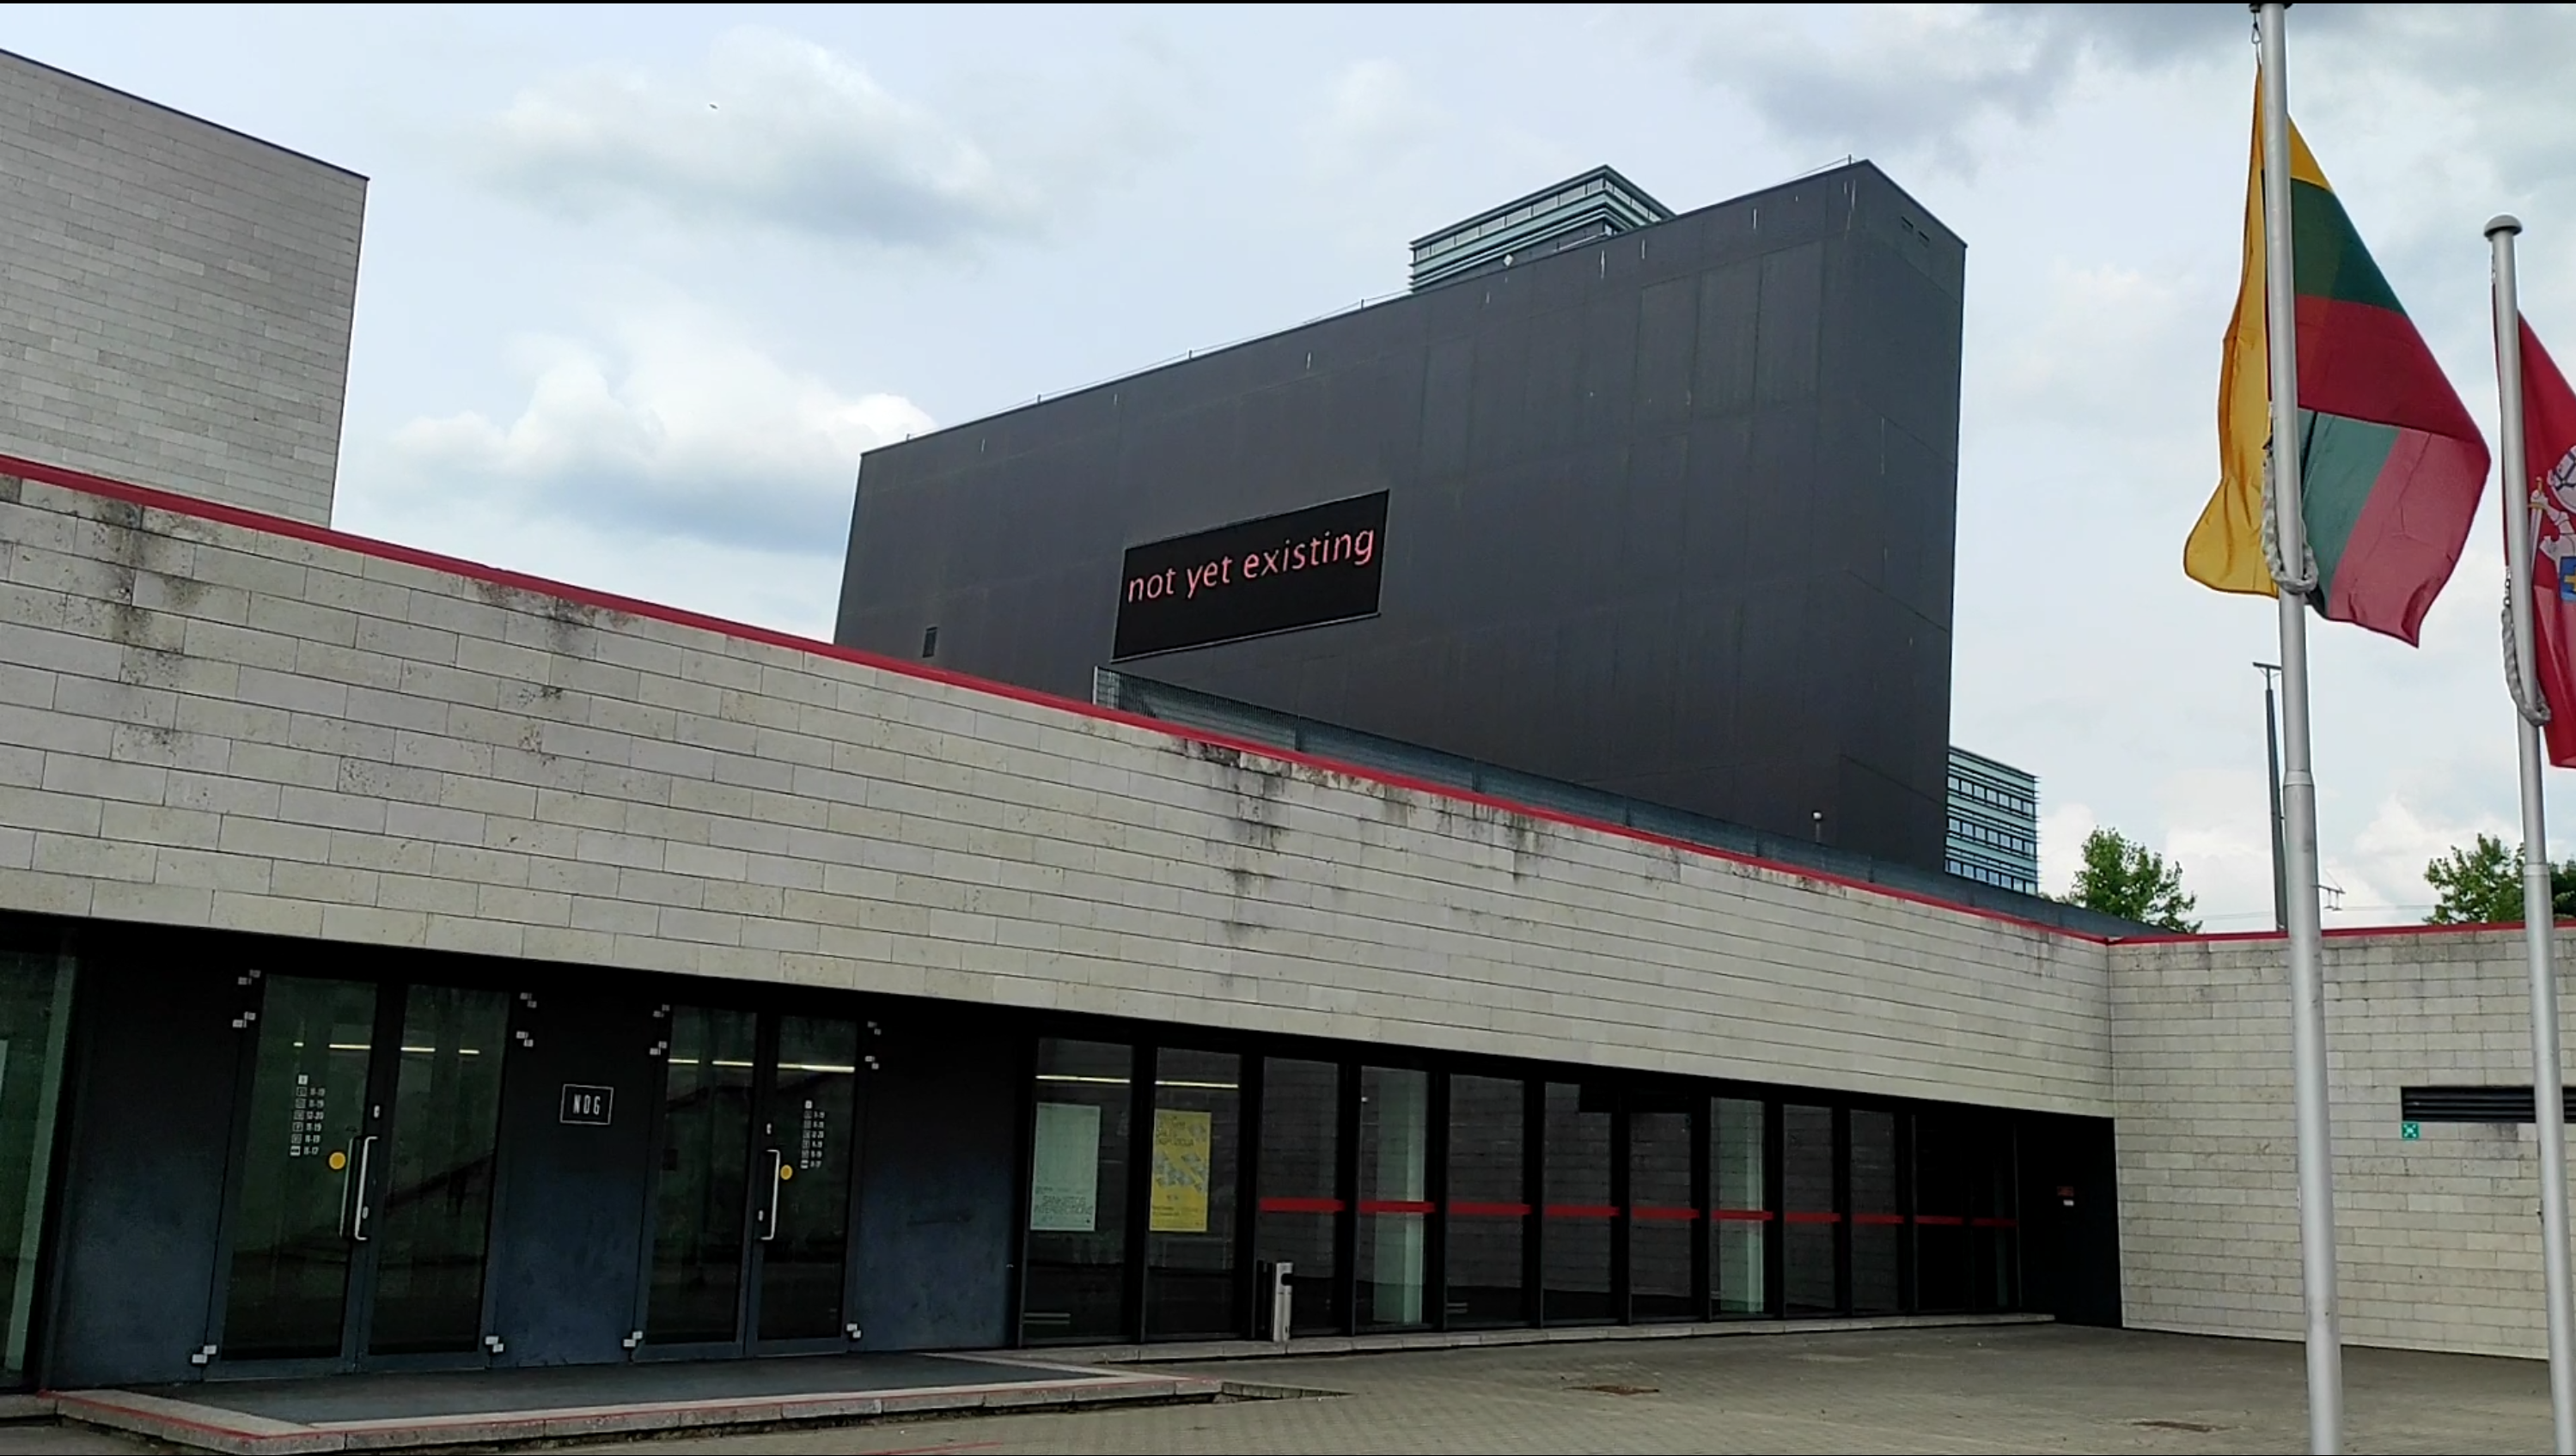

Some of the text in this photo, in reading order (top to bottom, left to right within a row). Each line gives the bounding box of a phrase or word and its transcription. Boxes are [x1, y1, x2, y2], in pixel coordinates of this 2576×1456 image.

[1127, 528, 1375, 603] not yet existing
